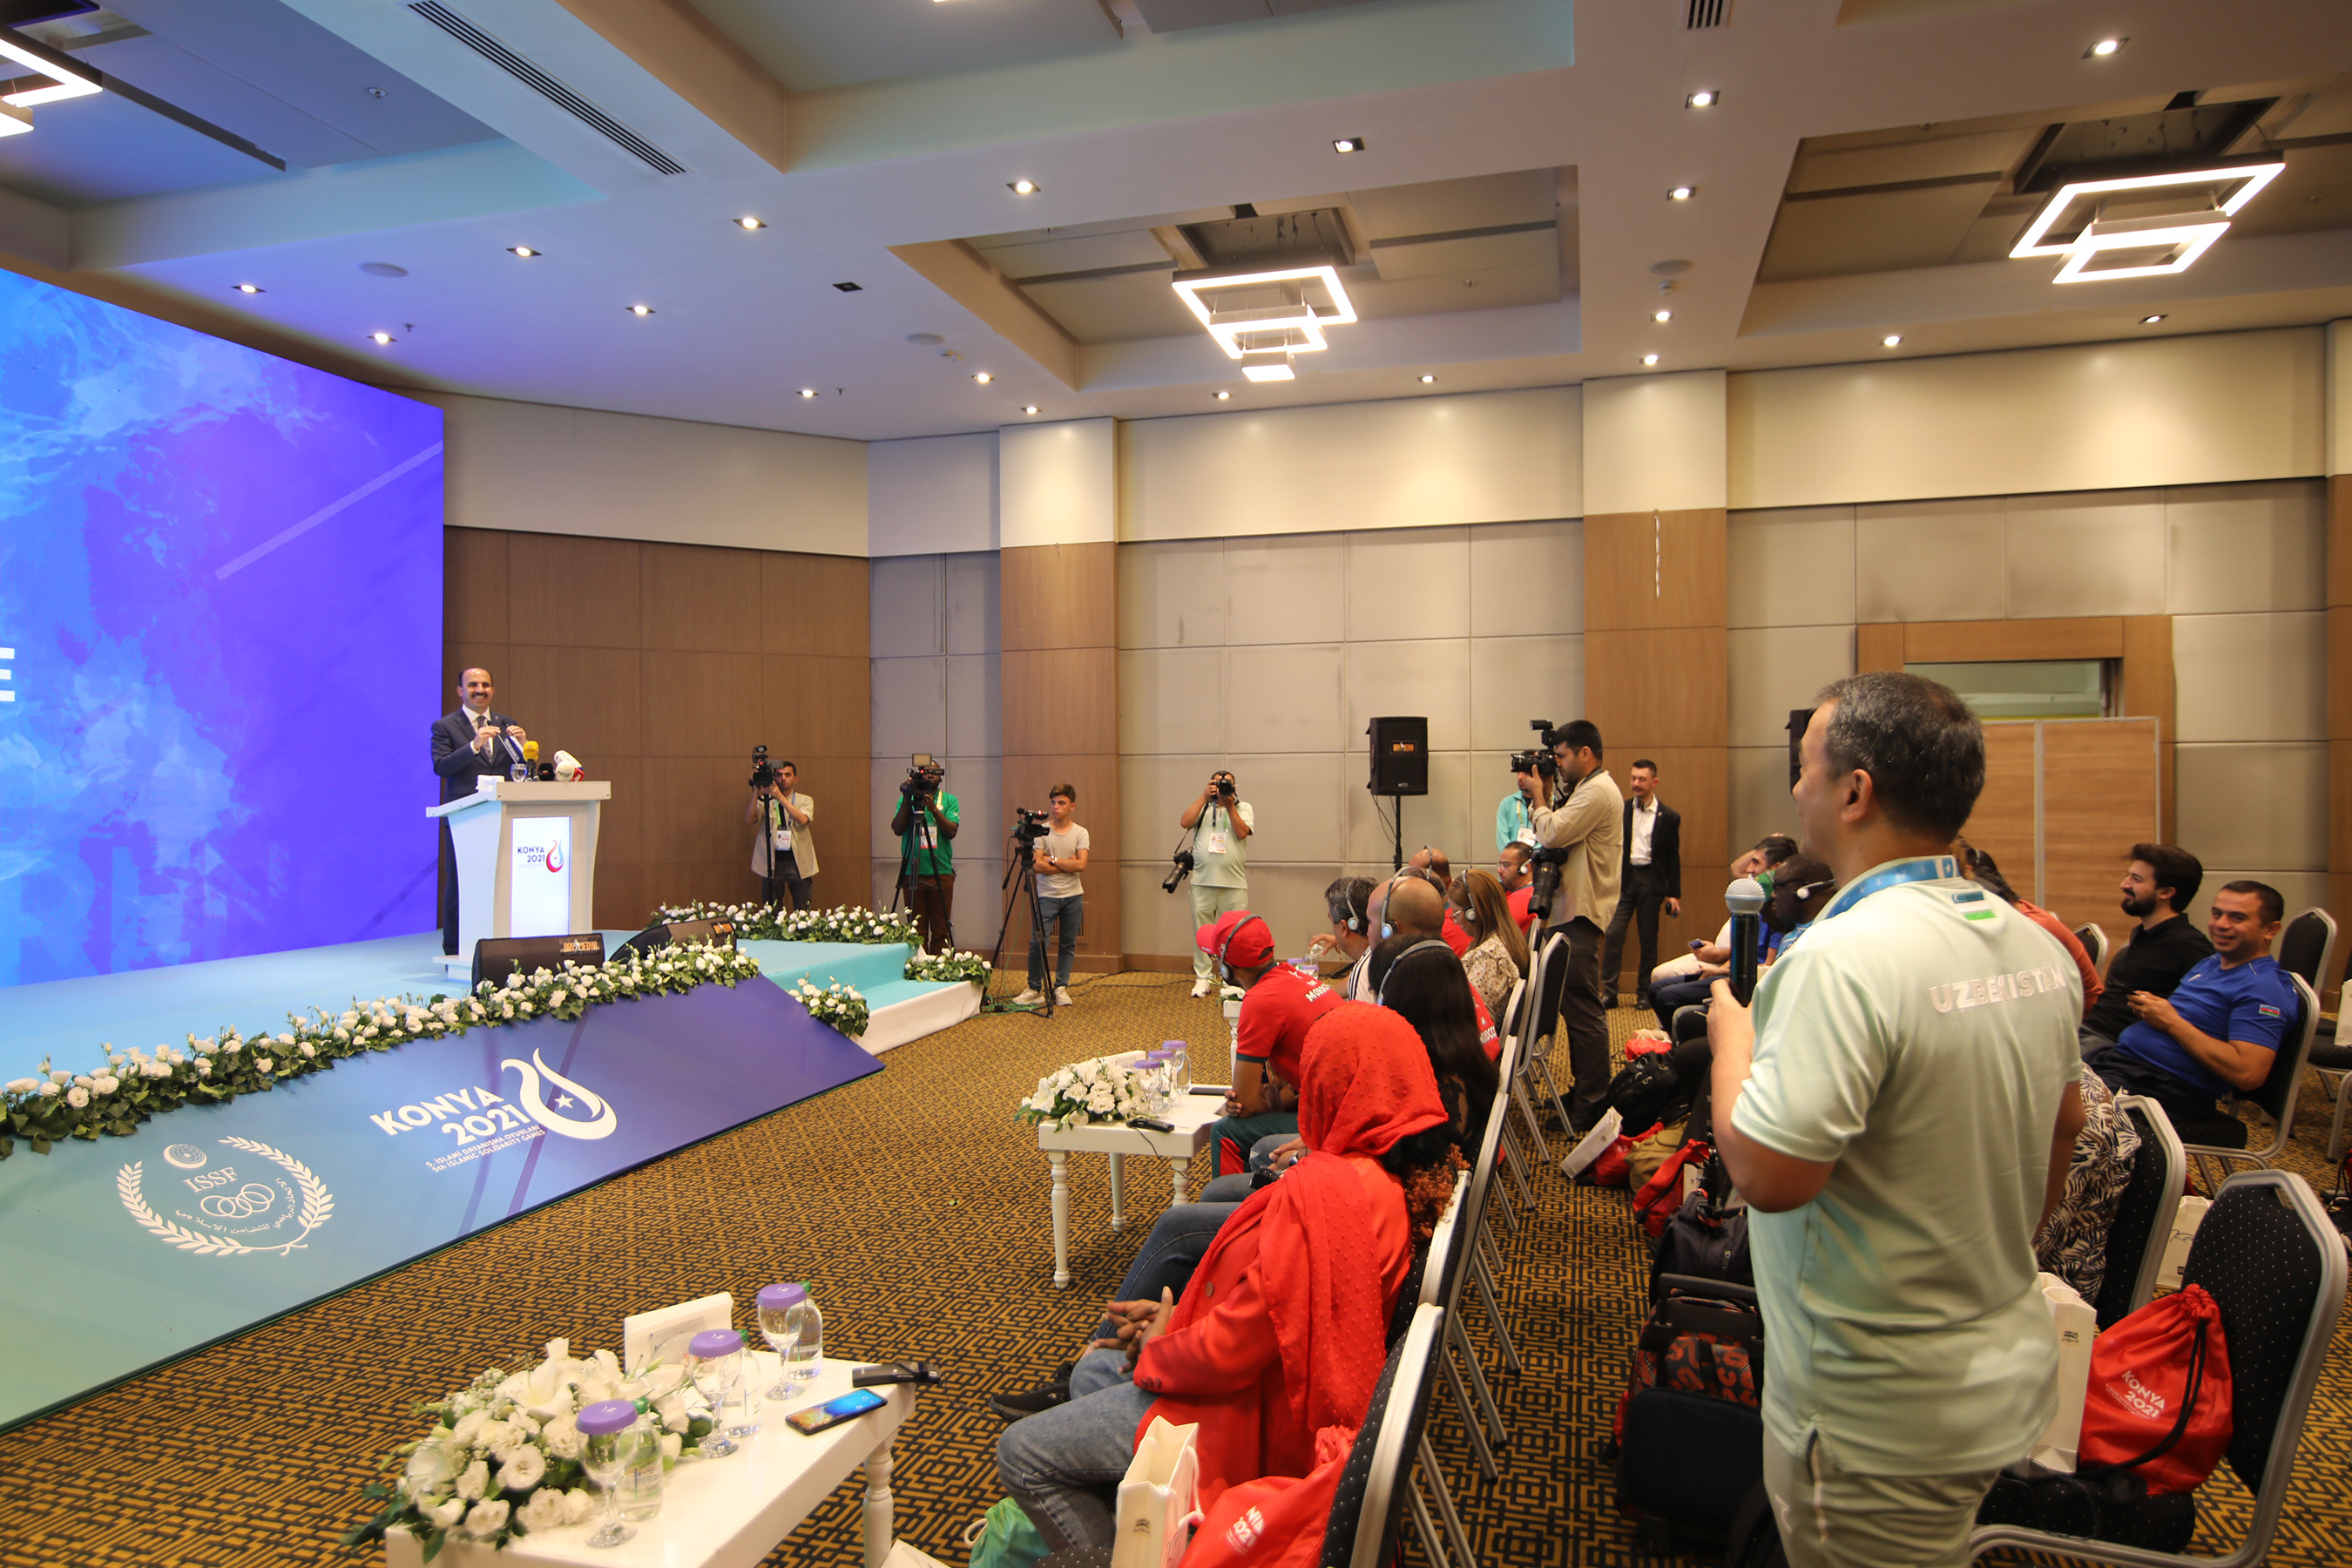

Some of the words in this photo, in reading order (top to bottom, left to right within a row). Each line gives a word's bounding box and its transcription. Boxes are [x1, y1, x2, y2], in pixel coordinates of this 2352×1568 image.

[517, 846, 544, 855] KONYA
[1929, 963, 2067, 1013] UZBEKISTAN
[369, 1085, 504, 1136] KONYA
[442, 1104, 531, 1146] 2021
[432, 1163, 447, 1173] 5th
[446, 1152, 479, 1168] ISLAMIC
[478, 1138, 521, 1157] SOLIDARITY
[521, 1129, 546, 1141] GAMES
[504, 1124, 541, 1141] OYUNLARI
[183, 1166, 238, 1193] ISSF
[2121, 1370, 2166, 1409] KONYA
[2125, 1390, 2159, 1417] 2021
